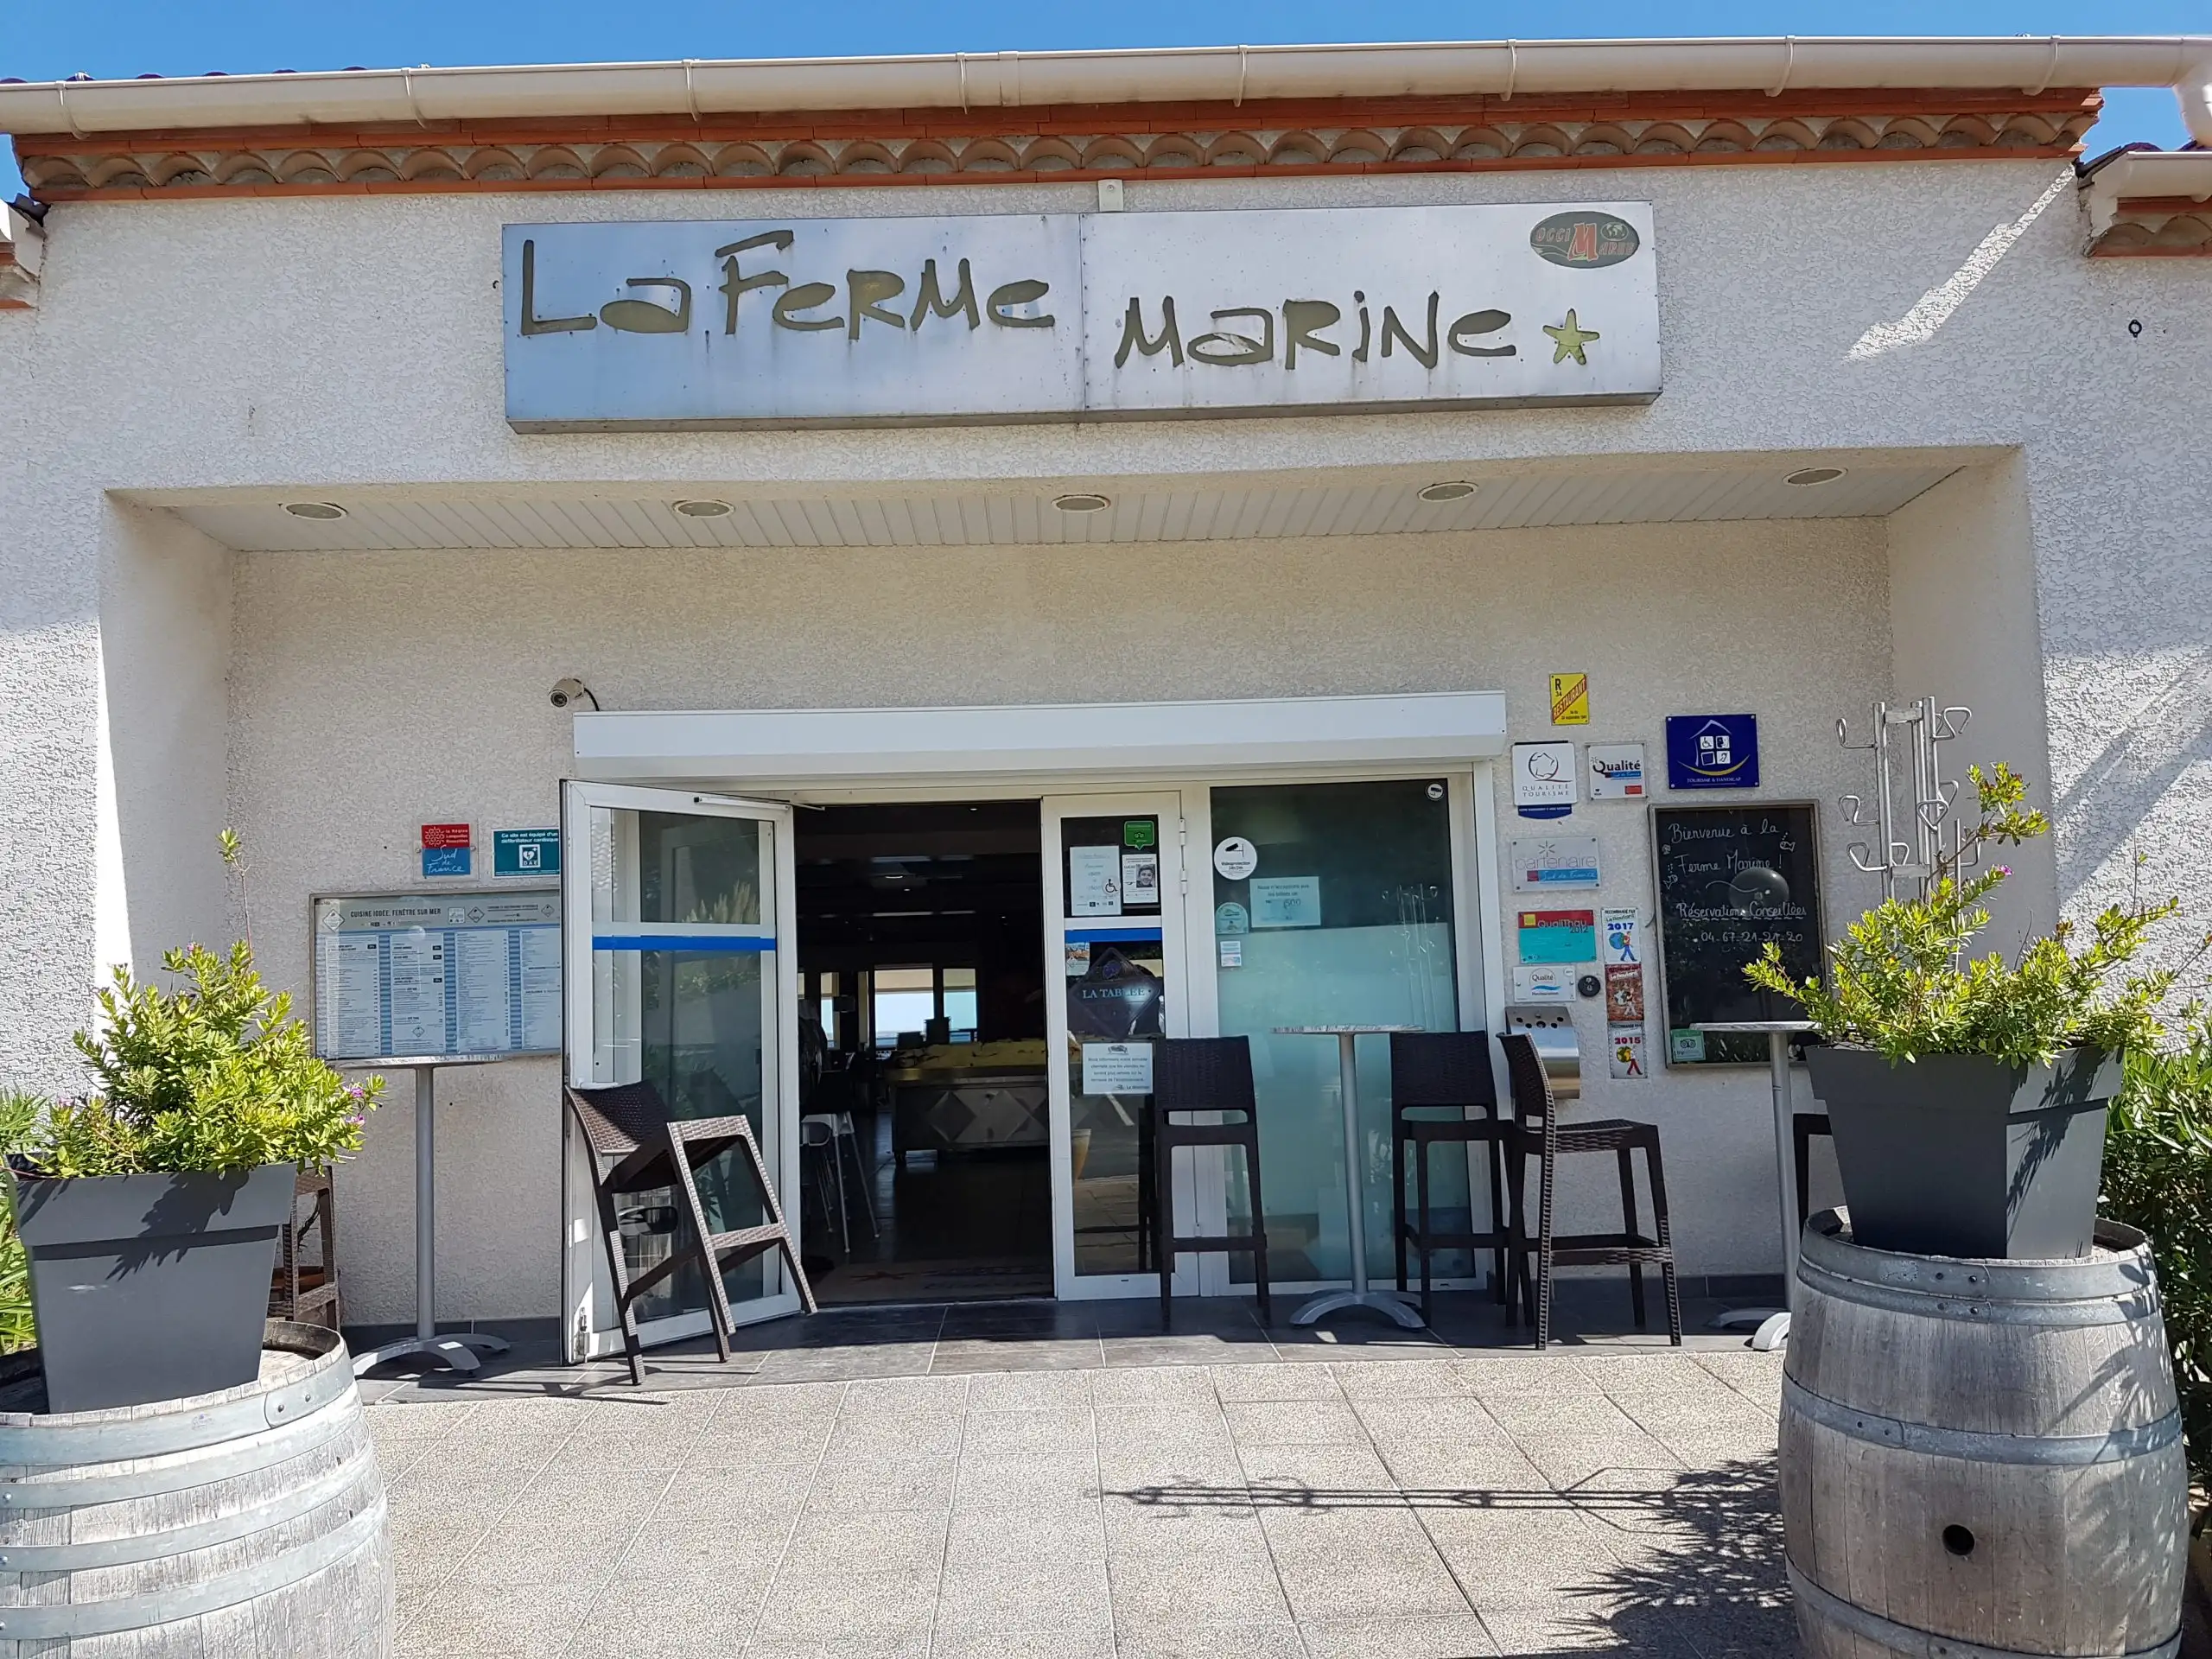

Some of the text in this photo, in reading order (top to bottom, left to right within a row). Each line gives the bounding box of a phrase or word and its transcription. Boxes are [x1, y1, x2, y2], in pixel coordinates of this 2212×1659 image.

[521, 238, 691, 335] La
[1554, 678, 1562, 690] R
[1553, 677, 1587, 721] RESTAURANT
[1592, 760, 1641, 775] Qualité
[1522, 783, 1569, 791] QUALITÉ
[1669, 818, 1780, 843] Bienvenue à la
[431, 844, 457, 861] Sud
[427, 862, 466, 874] France
[1515, 855, 1597, 870] partenaire
[1675, 849, 1783, 874] Ferme Marine !
[350, 909, 372, 918] CUISINE
[391, 908, 416, 917] FENÊTRE
[1569, 925, 1590, 934] 2012
[1083, 989, 1097, 999] LA
